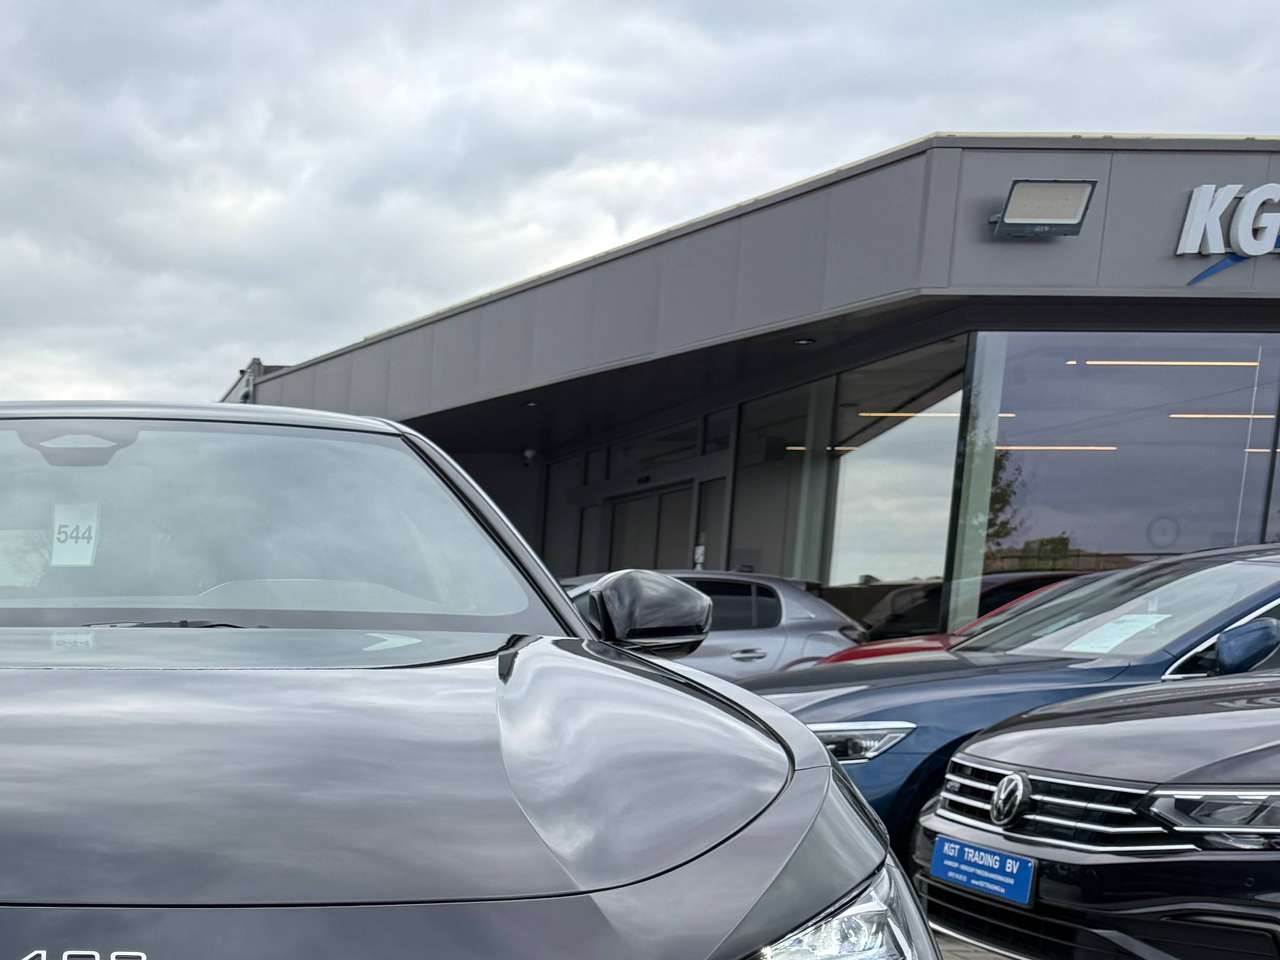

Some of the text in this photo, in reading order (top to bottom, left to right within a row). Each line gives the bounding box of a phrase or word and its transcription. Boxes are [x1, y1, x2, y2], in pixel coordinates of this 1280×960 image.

[56, 524, 93, 544] 544
[943, 842, 960, 857] KGT
[964, 847, 1000, 869] TRADING
[1005, 859, 1020, 874] BV
